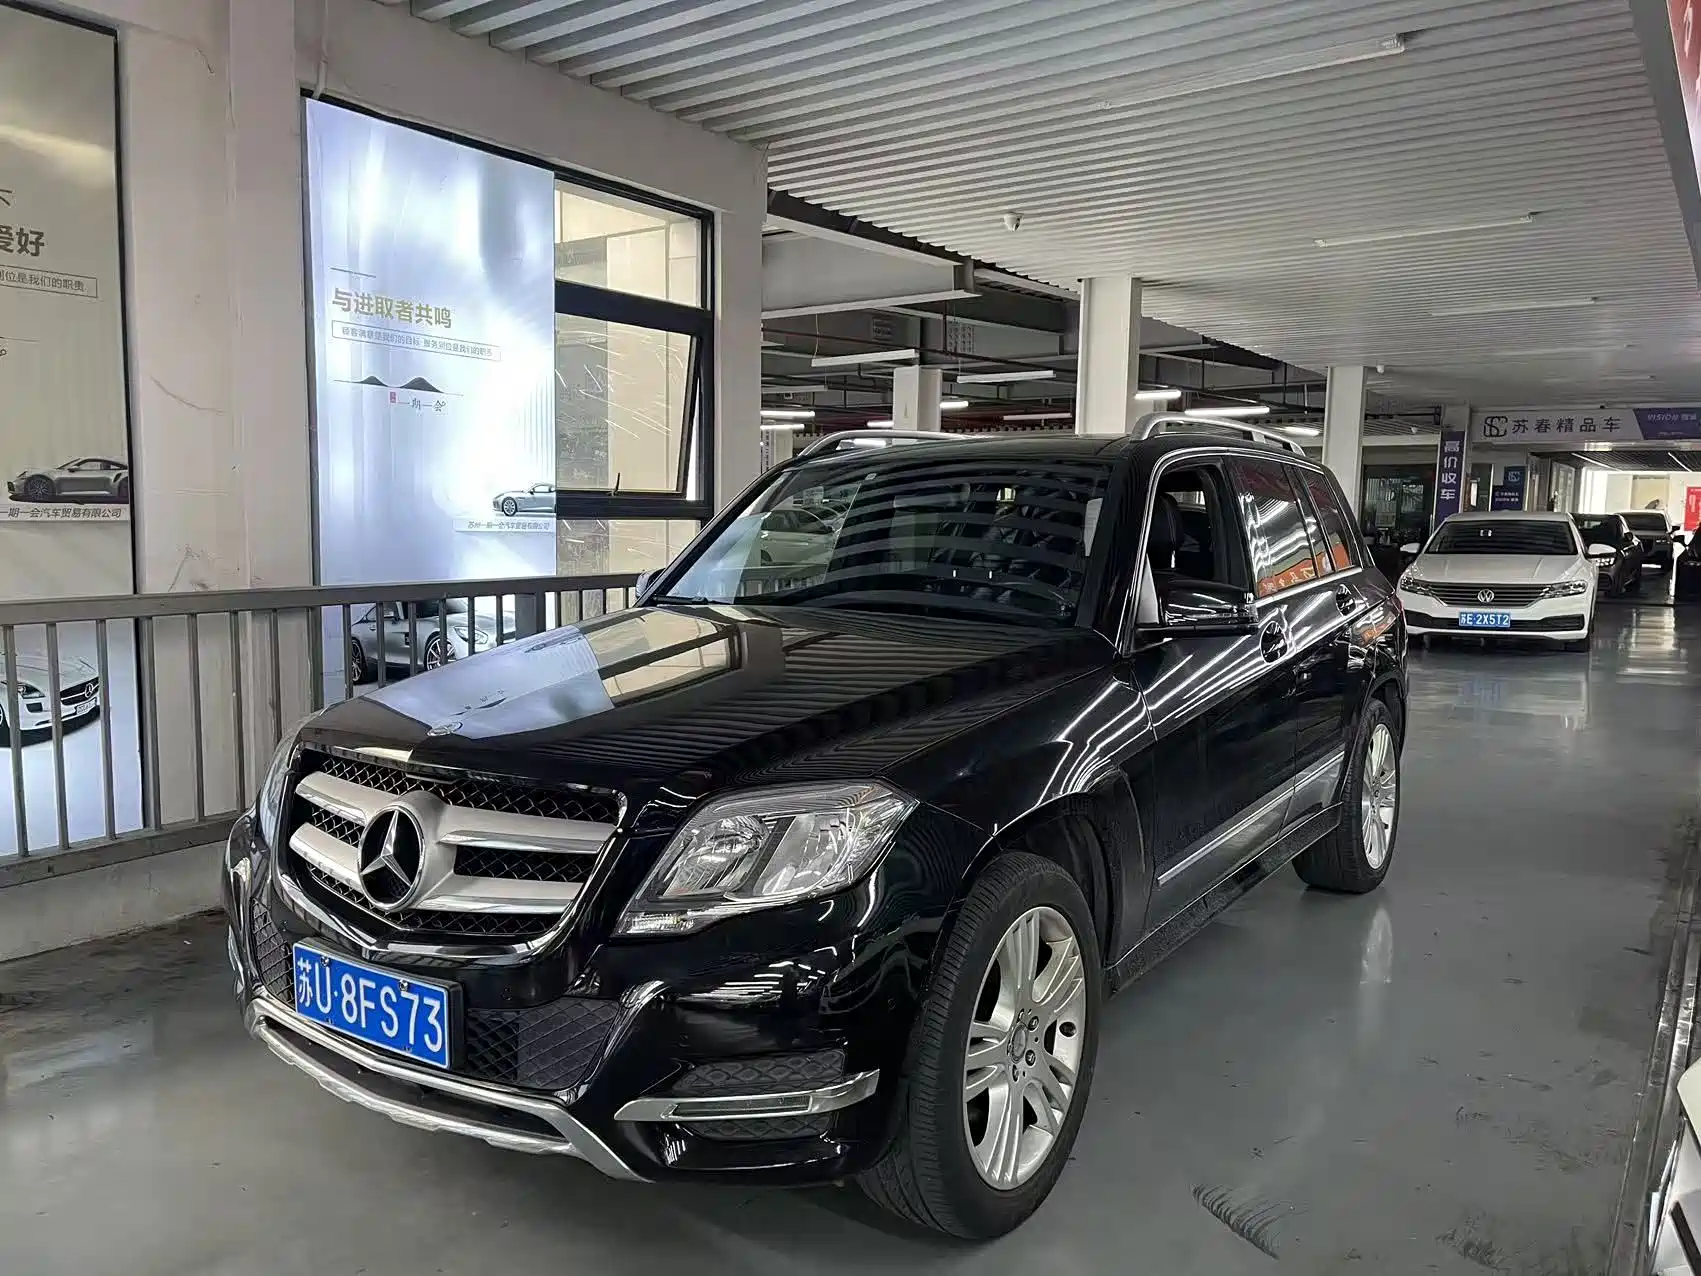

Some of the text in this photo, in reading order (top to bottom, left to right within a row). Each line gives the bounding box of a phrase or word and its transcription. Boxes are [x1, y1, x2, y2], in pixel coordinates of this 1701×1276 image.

[332, 287, 452, 329] 与进取者共鸣
[1511, 417, 1621, 434] 苏春精品车
[1440, 440, 1460, 500] 高价收车
[297, 957, 443, 1053] 苏U·8FS73
